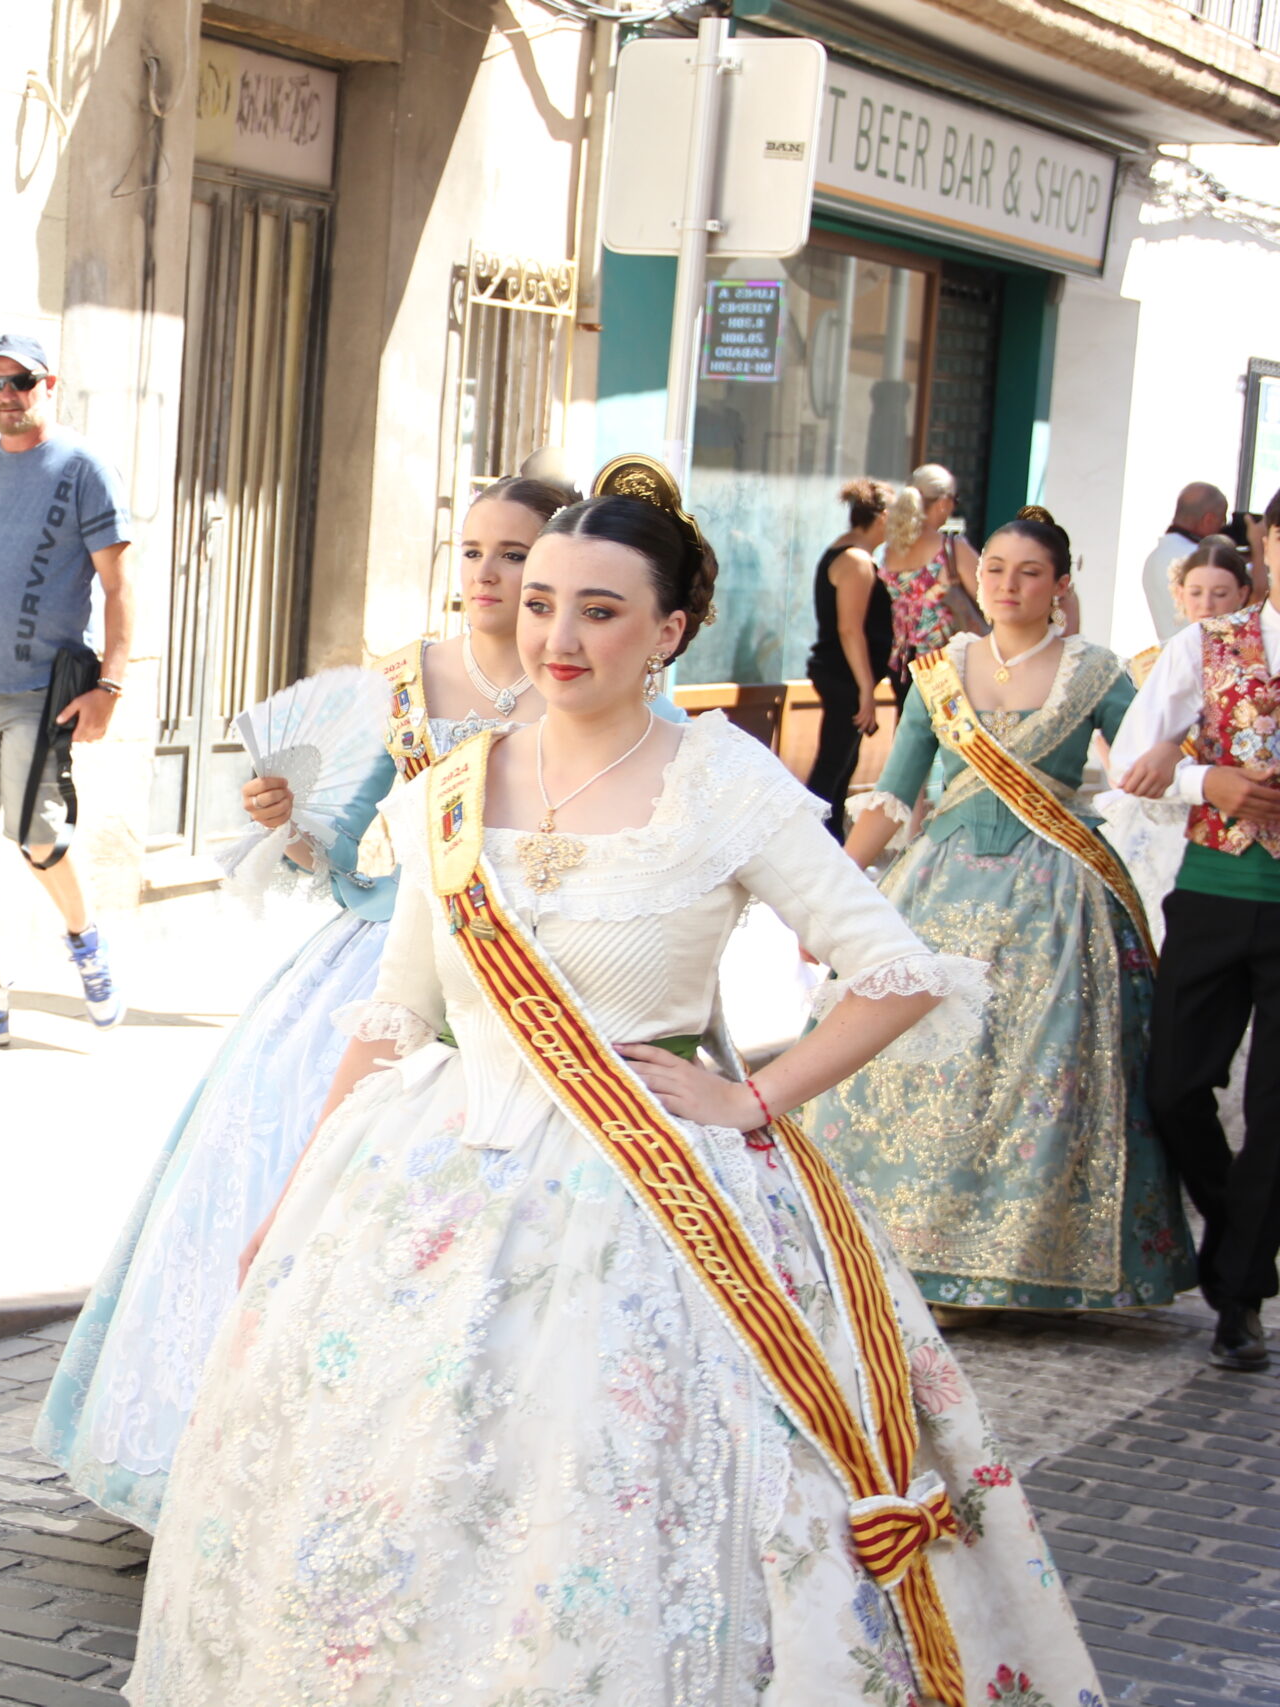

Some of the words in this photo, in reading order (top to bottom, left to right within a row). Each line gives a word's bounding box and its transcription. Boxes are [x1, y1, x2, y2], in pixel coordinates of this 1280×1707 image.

[828, 86, 847, 164] T
[854, 96, 931, 191] BEER
[939, 125, 995, 209] BAR
[1002, 145, 1023, 219] &
[1030, 156, 1101, 237] SHOP
[14, 480, 73, 663] SURVIVOR
[510, 995, 592, 1082] Cort
